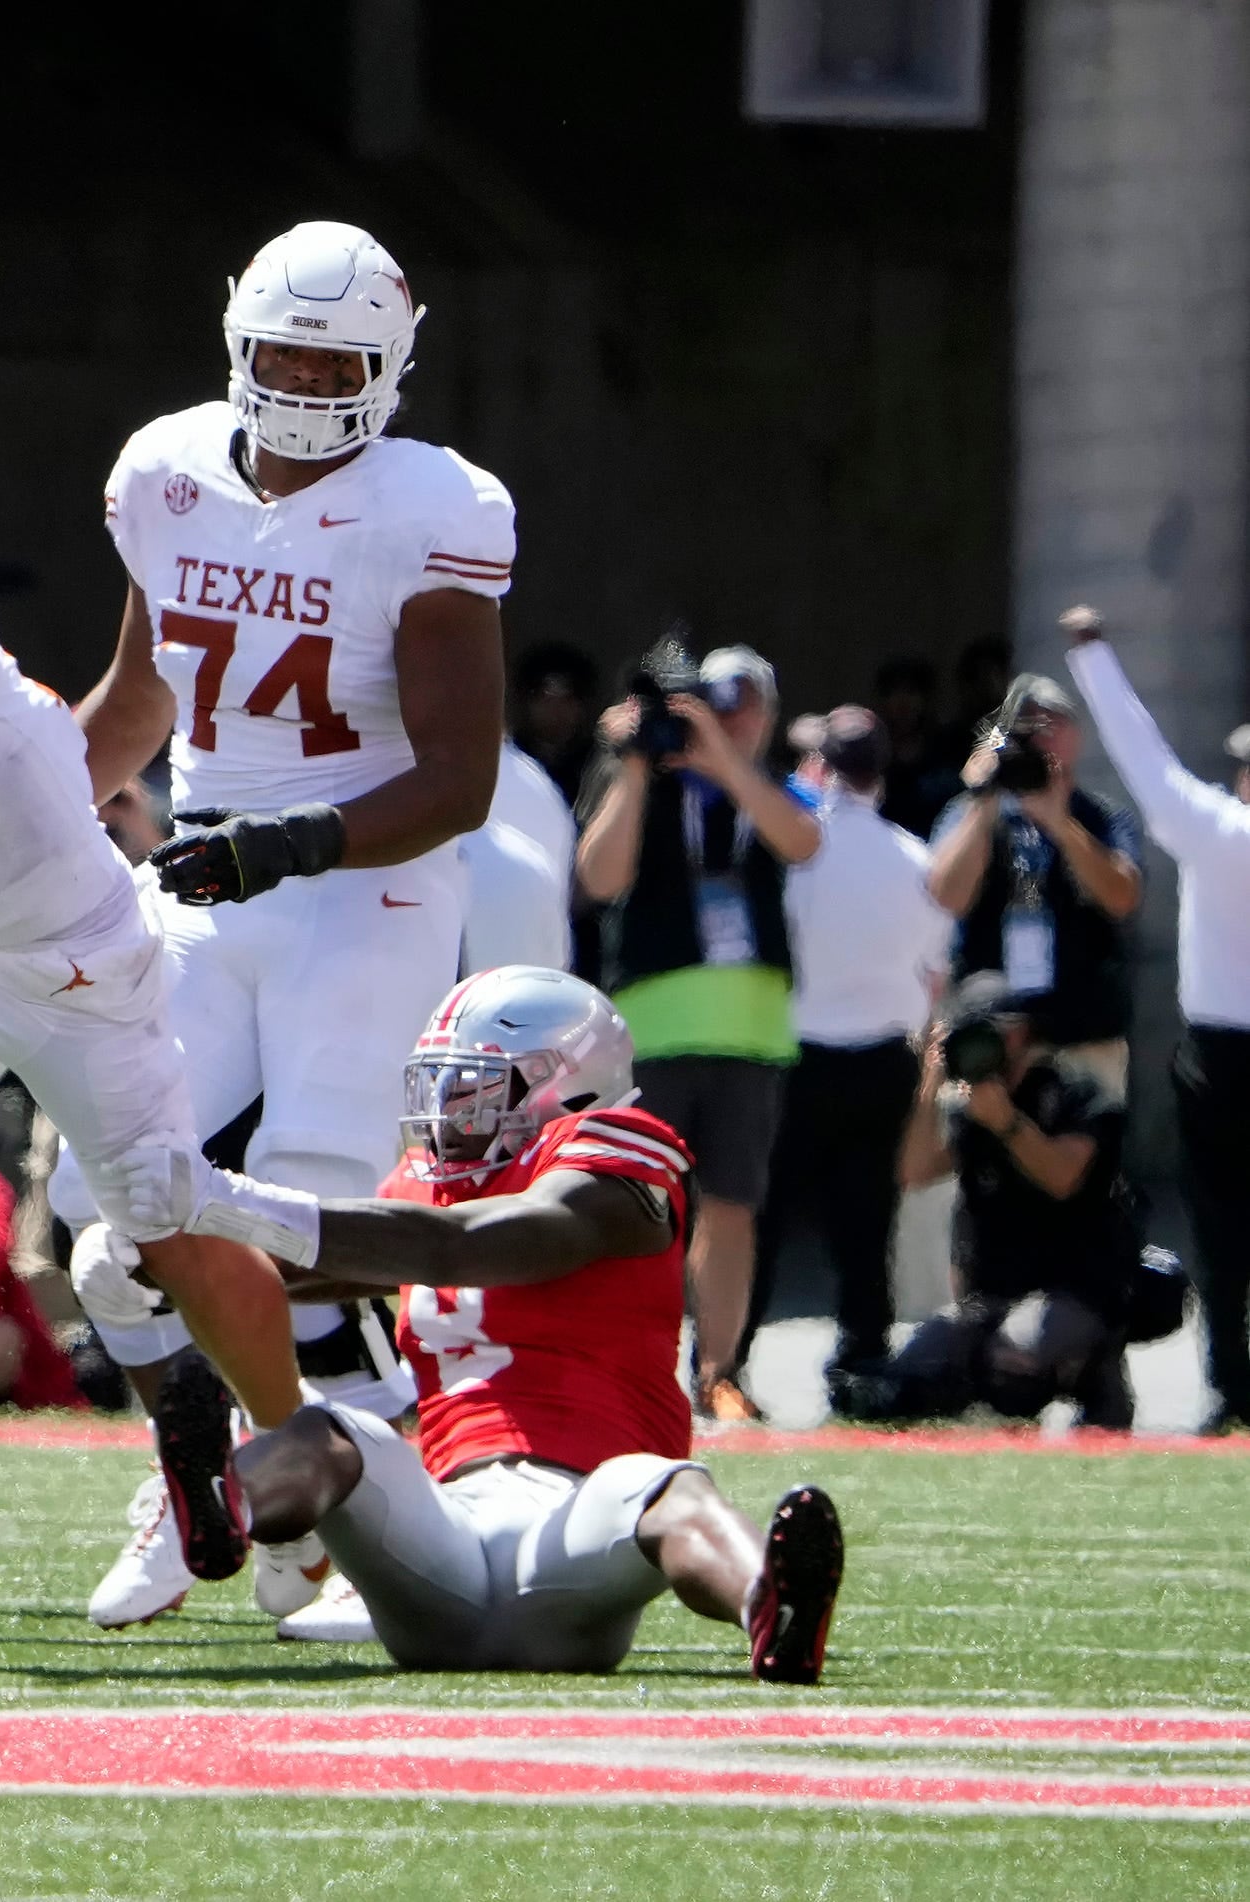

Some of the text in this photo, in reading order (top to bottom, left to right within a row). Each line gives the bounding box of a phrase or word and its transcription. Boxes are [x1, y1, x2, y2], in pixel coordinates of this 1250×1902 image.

[291, 315, 329, 330] HORNS
[174, 556, 333, 626] TEXAS
[159, 608, 361, 758] 74
